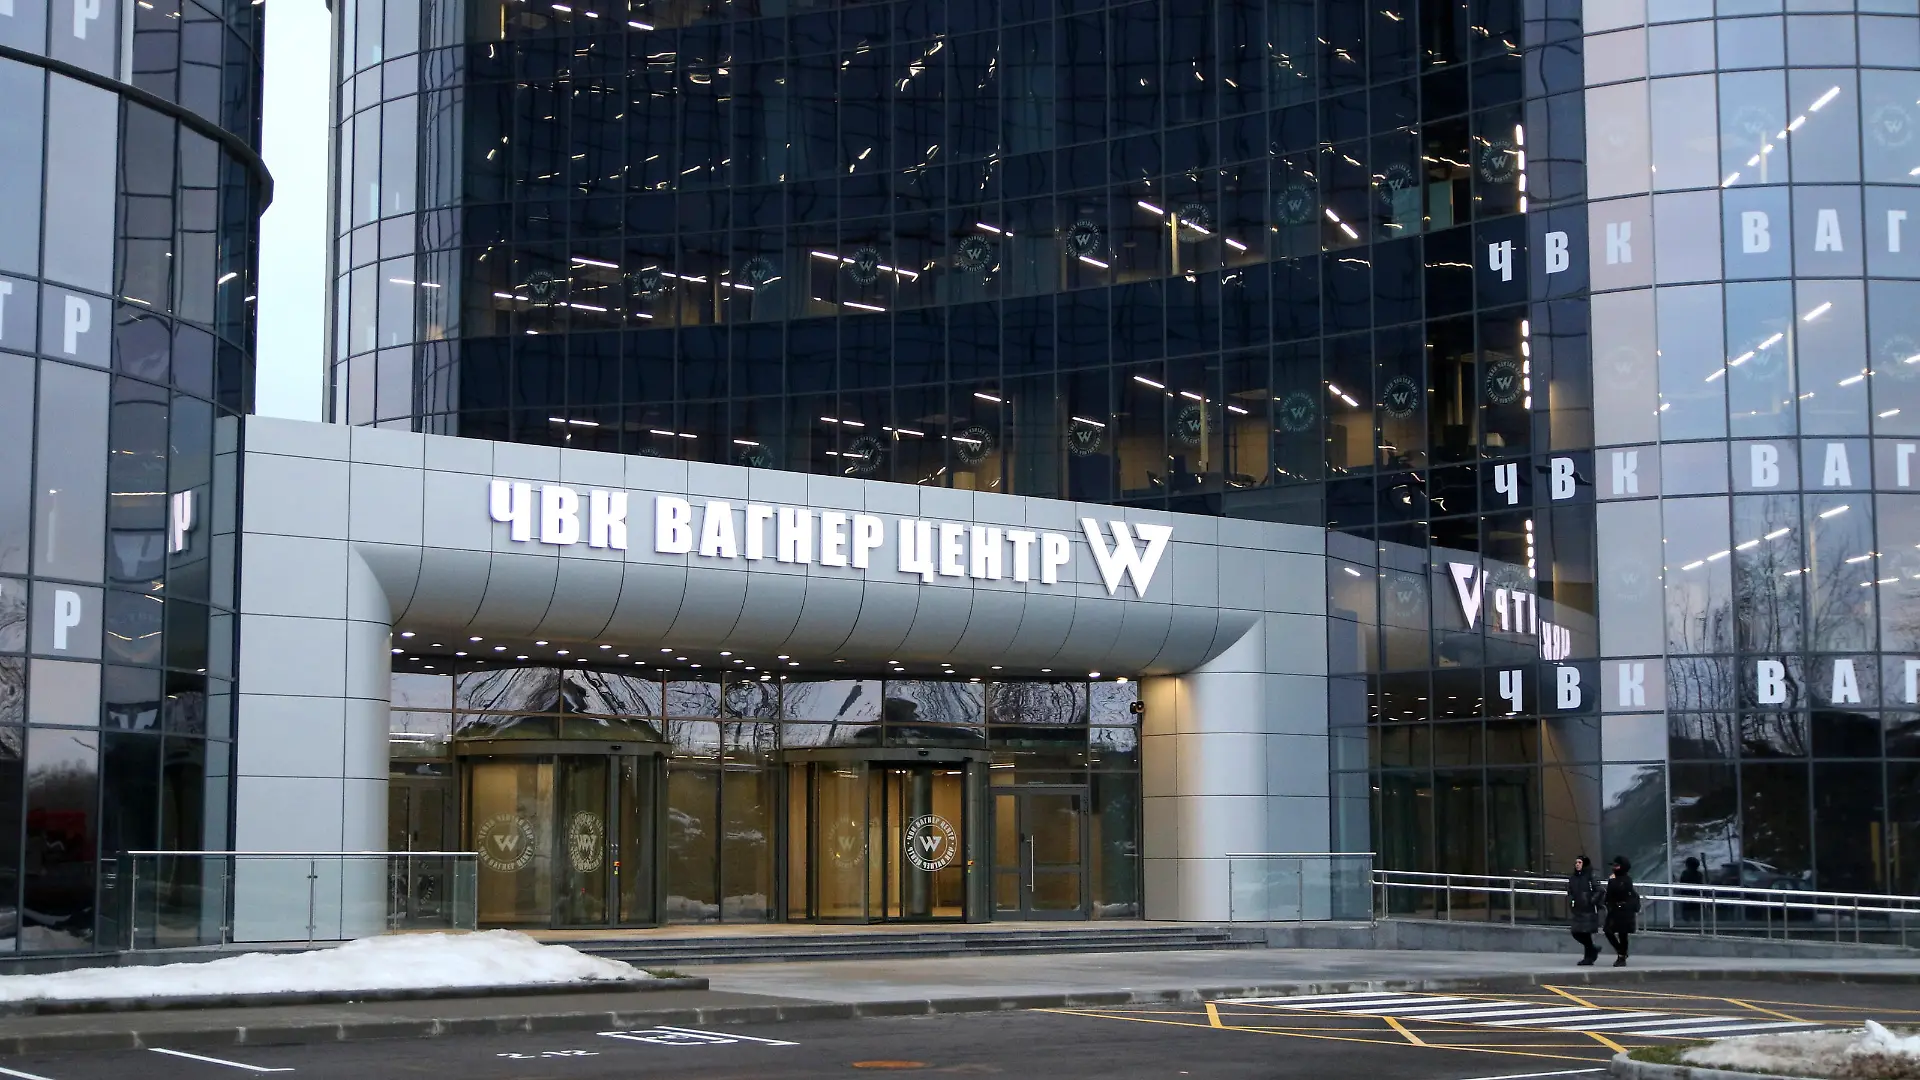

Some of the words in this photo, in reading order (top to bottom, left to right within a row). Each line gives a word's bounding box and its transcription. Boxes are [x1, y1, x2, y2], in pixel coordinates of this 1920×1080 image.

[489, 479, 628, 550] ЧВК
[655, 495, 884, 569] ВАГНЕР
[897, 518, 1070, 584] ЦЕНТР
